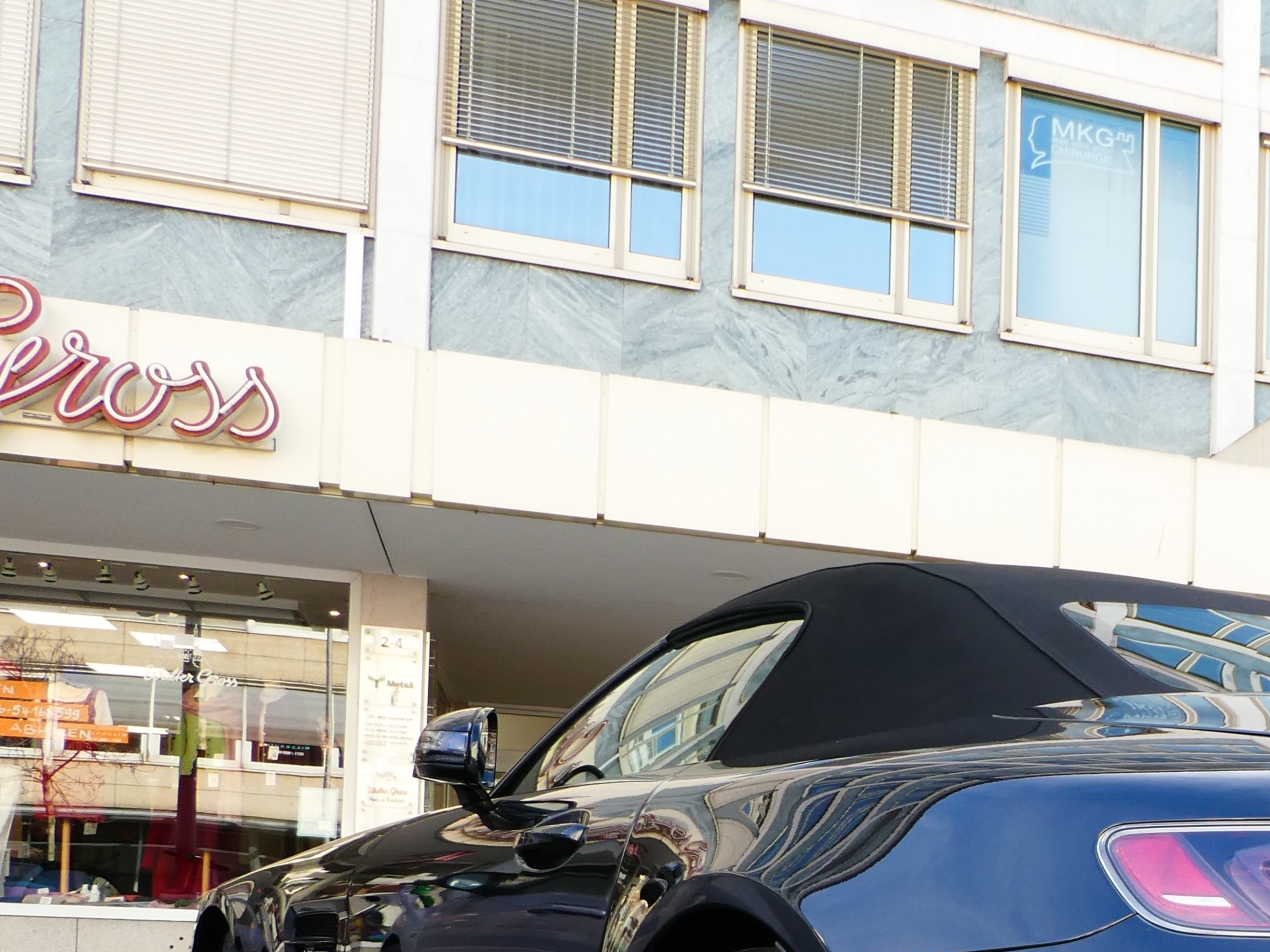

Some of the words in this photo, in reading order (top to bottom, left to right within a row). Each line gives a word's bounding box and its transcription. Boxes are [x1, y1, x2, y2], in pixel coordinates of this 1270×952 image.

[1052, 117, 1114, 148] MKG
[1052, 145, 1114, 165] CHIRURGIE
[381, 637, 403, 649] 2-4
[143, 664, 195, 684] Walter
[196, 668, 239, 688] Gross
[387, 679, 414, 689] Metsä
[9, 721, 92, 740] ABHEN
